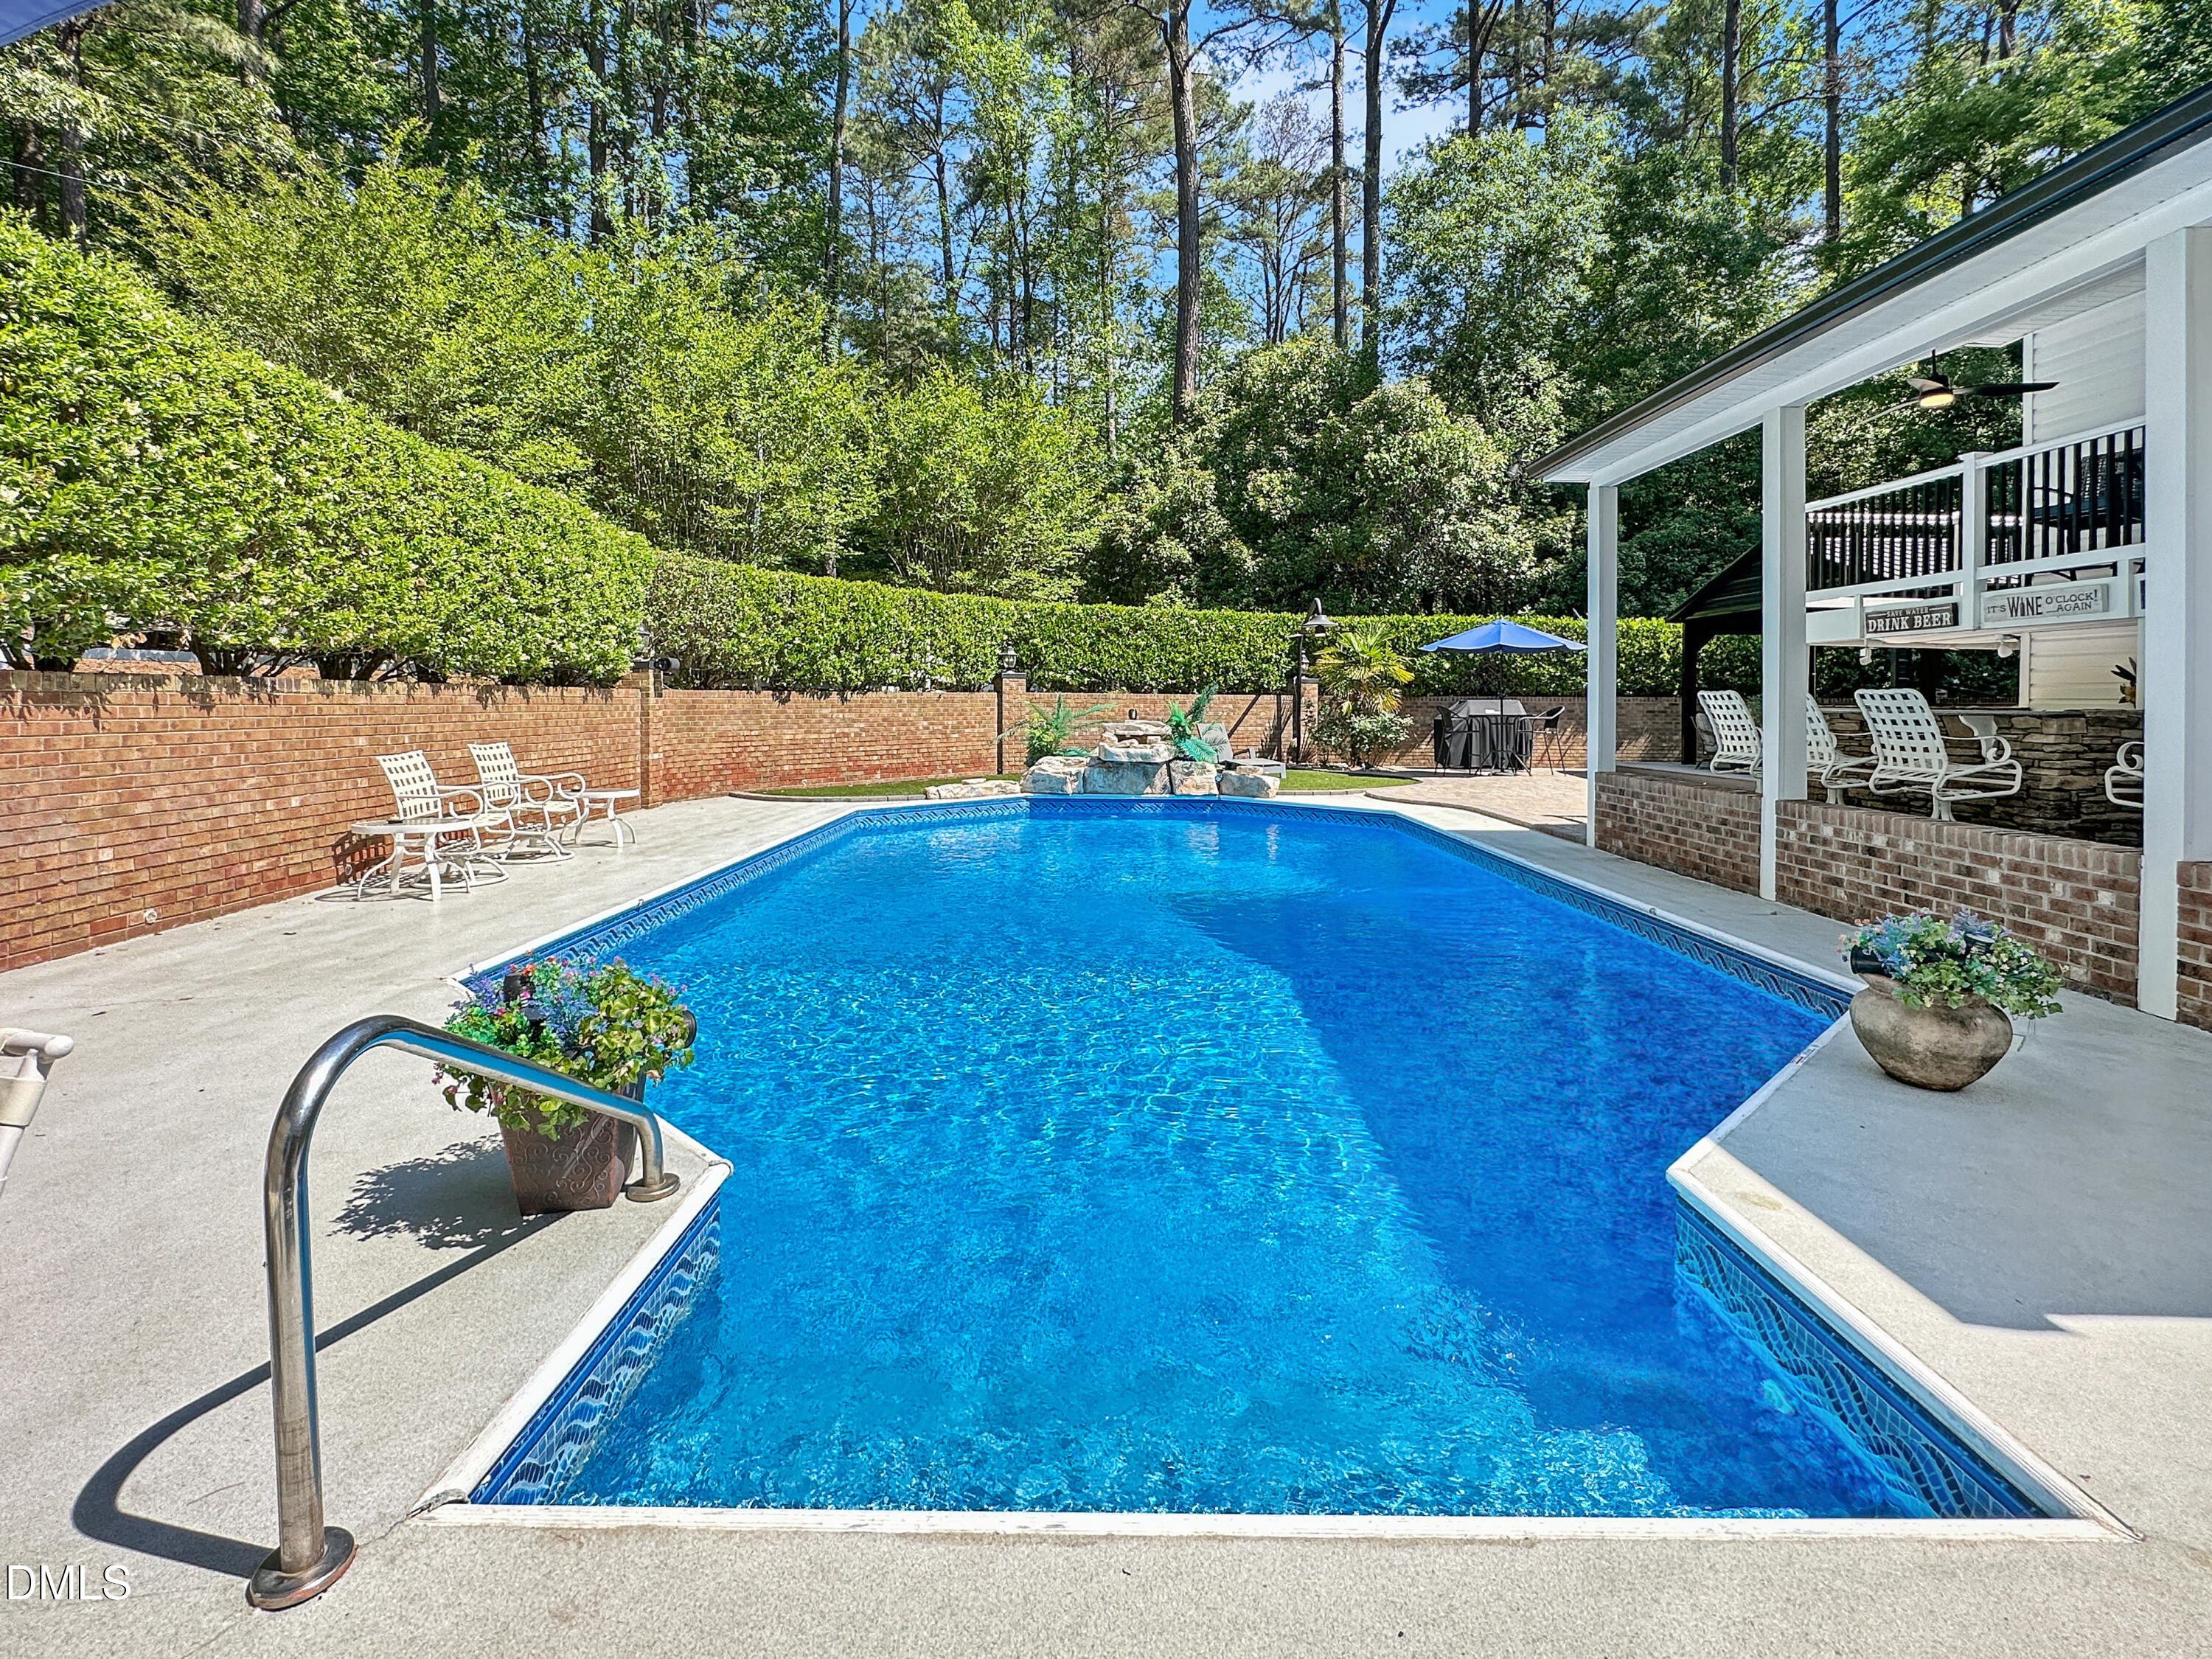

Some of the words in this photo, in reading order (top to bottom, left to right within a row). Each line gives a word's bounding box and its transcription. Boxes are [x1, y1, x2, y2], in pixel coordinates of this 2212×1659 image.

[1905, 607, 1929, 615] WATER
[1987, 605, 2006, 613] IT'S
[2007, 596, 2043, 617] WINE
[2045, 589, 2098, 605] O'CLOCK!
[1868, 616, 1910, 632] DRINK
[1913, 612, 1952, 628] BEER
